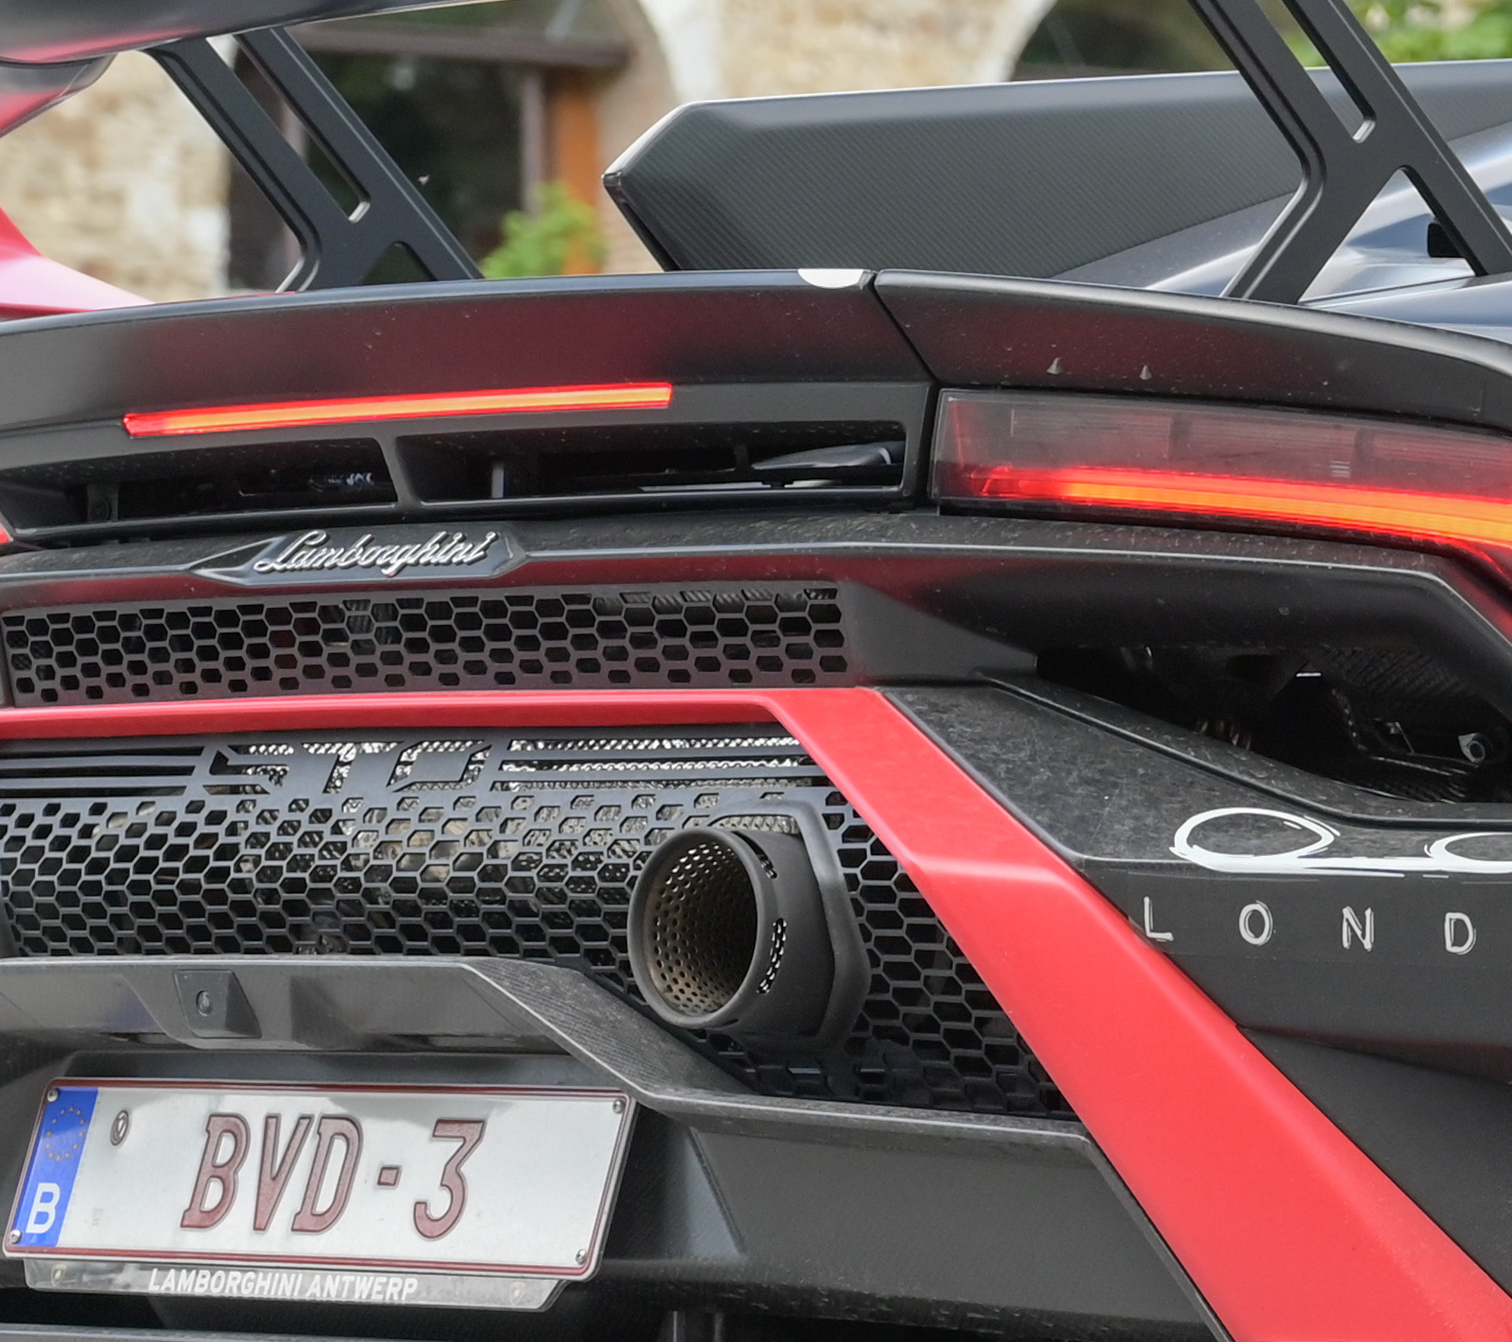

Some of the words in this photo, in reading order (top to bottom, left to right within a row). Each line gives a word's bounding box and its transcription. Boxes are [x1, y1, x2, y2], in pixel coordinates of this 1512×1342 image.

[254, 528, 496, 576] Lamborghini
[25, 1182, 61, 1234] B
[147, 1267, 304, 1298] LAMBORGHINI
[305, 1273, 419, 1301] ANTWERP
